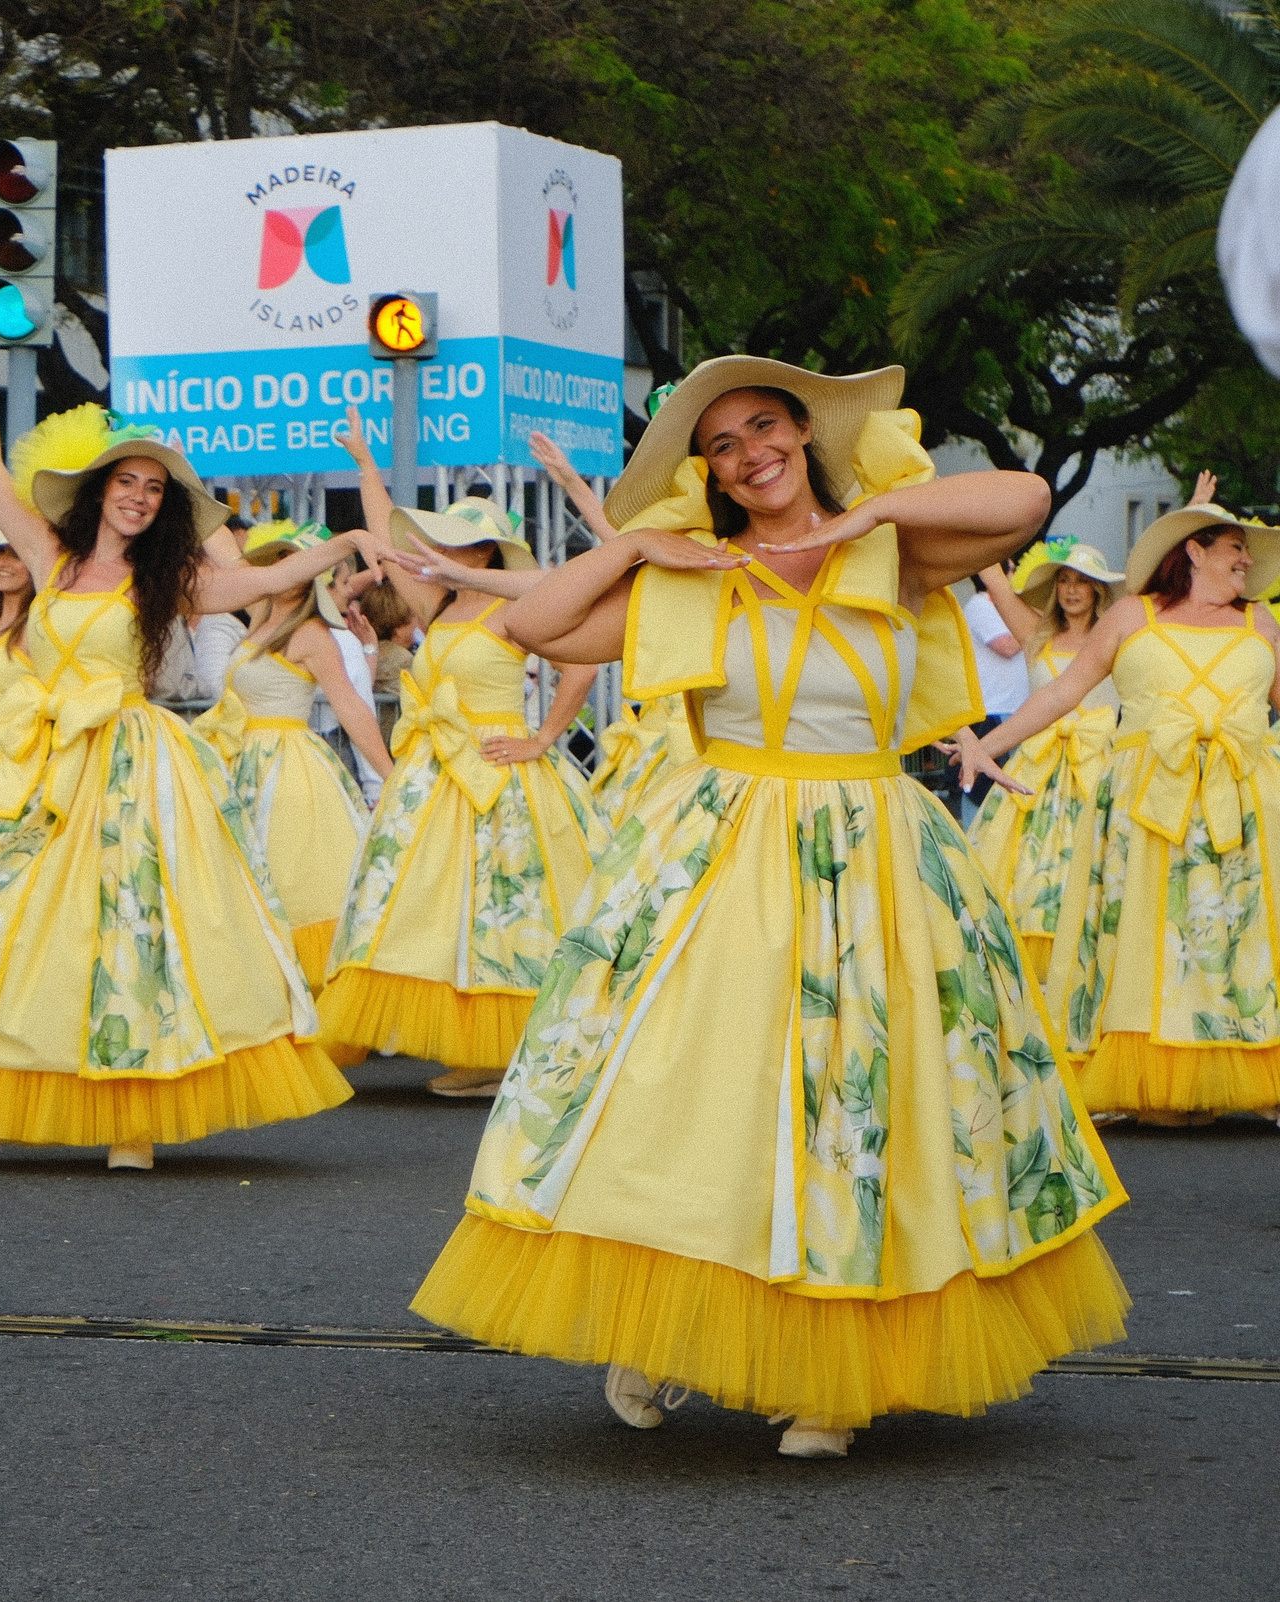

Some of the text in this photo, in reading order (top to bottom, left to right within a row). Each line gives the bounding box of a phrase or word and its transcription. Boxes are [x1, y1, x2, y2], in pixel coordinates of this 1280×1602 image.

[245, 164, 357, 206] MADEIRA
[249, 293, 360, 332] ISLANDS
[125, 362, 486, 415] INÍCIO DO COREJO
[286, 412, 470, 450] BEGNNG
